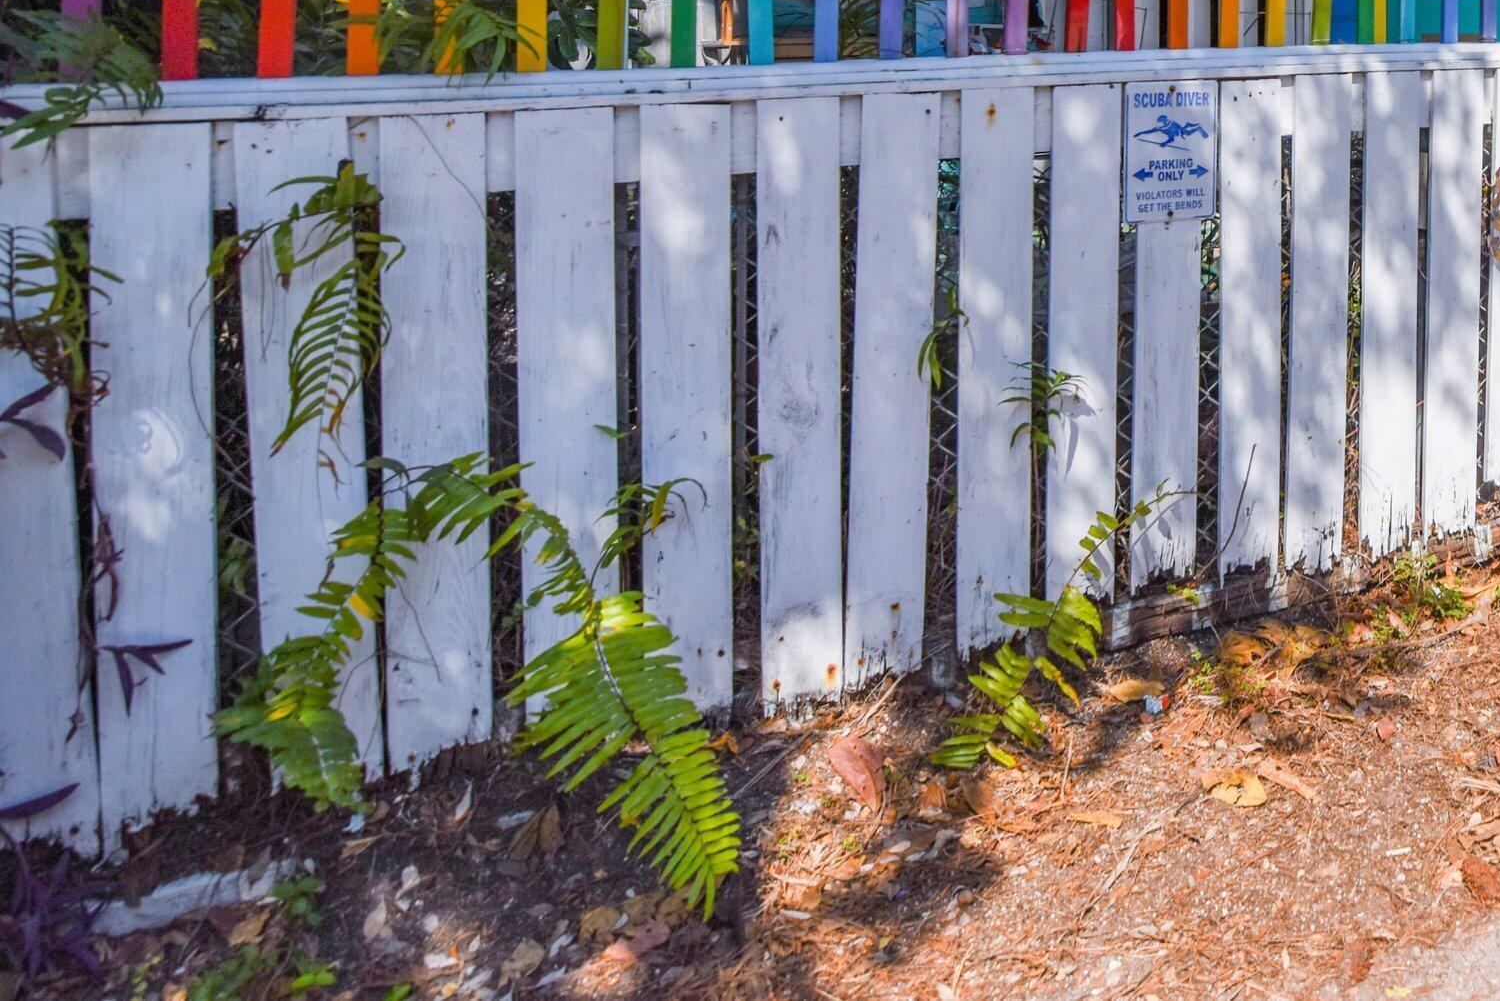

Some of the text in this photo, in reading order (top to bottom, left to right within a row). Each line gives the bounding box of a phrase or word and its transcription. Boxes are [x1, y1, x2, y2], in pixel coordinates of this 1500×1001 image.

[1133, 91, 1210, 109] SCUBA DIVER
[1148, 157, 1194, 171] PARKING
[1157, 170, 1185, 182] ONLY
[1135, 187, 1206, 201] VIOLATORS WILL
[1137, 199, 1203, 214] GET THE BENDS
